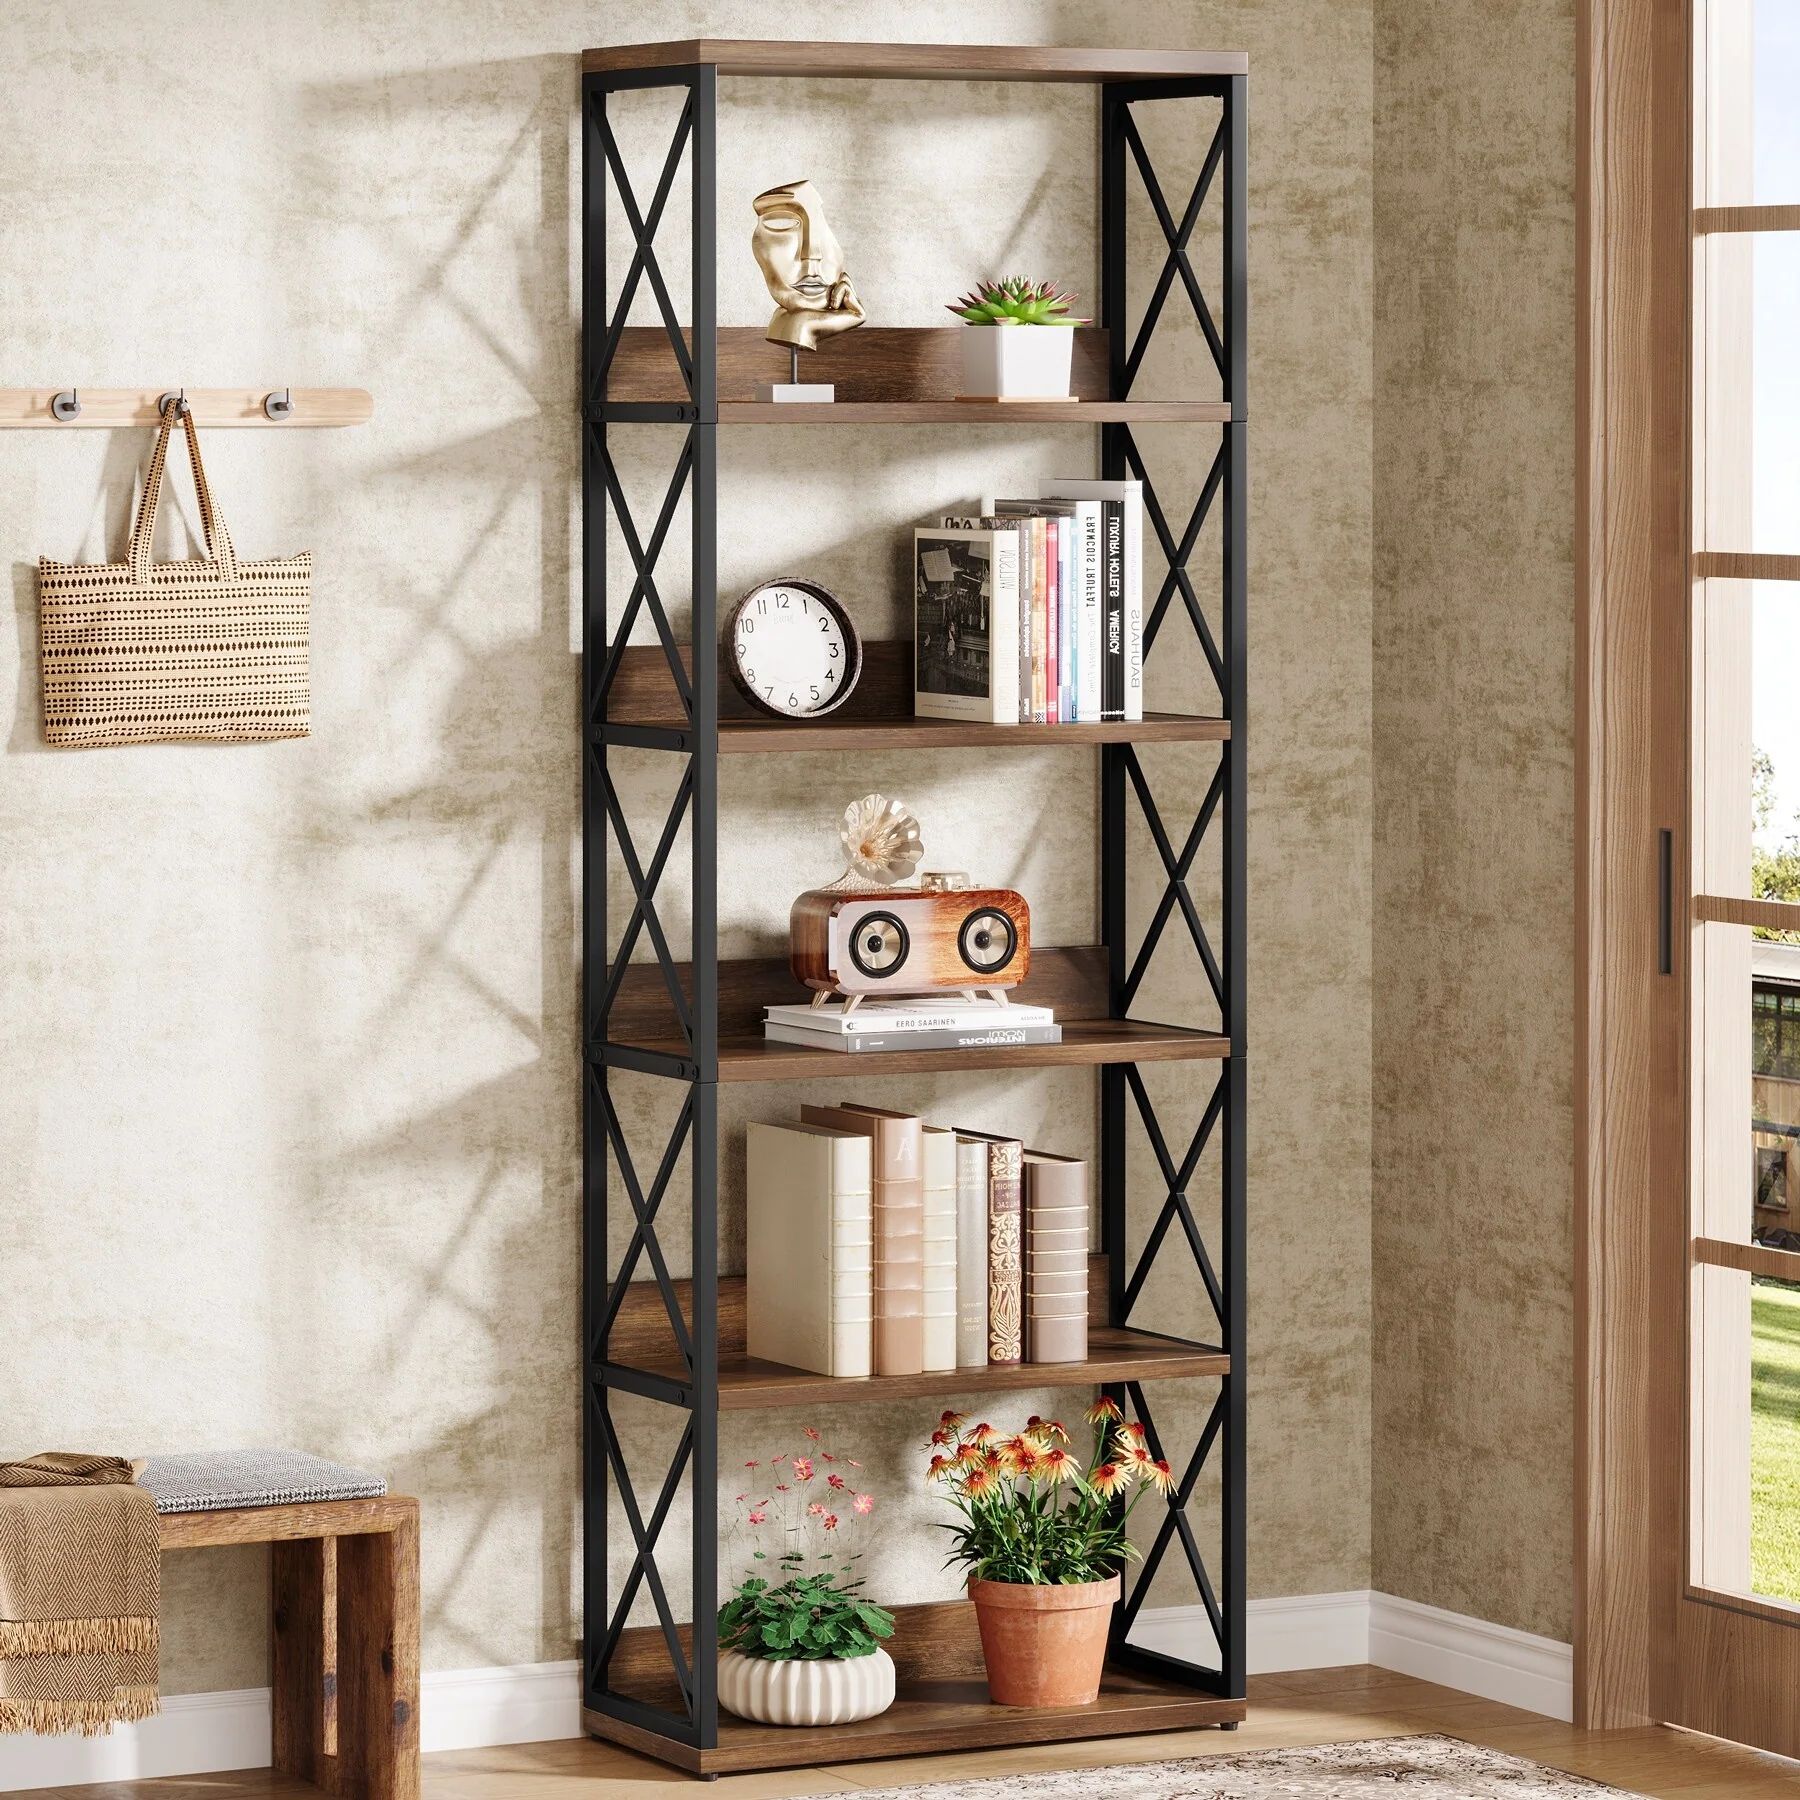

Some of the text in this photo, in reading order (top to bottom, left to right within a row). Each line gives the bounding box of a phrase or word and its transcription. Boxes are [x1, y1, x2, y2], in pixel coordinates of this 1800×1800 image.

[757, 600, 767, 614] 11
[775, 593, 790, 608] 12
[803, 599, 808, 614] 1
[740, 618, 754, 633] 10
[818, 617, 829, 632] 2
[737, 643, 747, 659] 9
[828, 642, 839, 658] 3
[746, 668, 756, 684] 8
[824, 669, 835, 683] 4
[764, 686, 774, 700] 7
[788, 692, 799, 708] 6
[809, 685, 820, 701] 5
[896, 1018, 956, 1028] EERO SAARINEN
[958, 1035, 1026, 1046] INTERIORS
